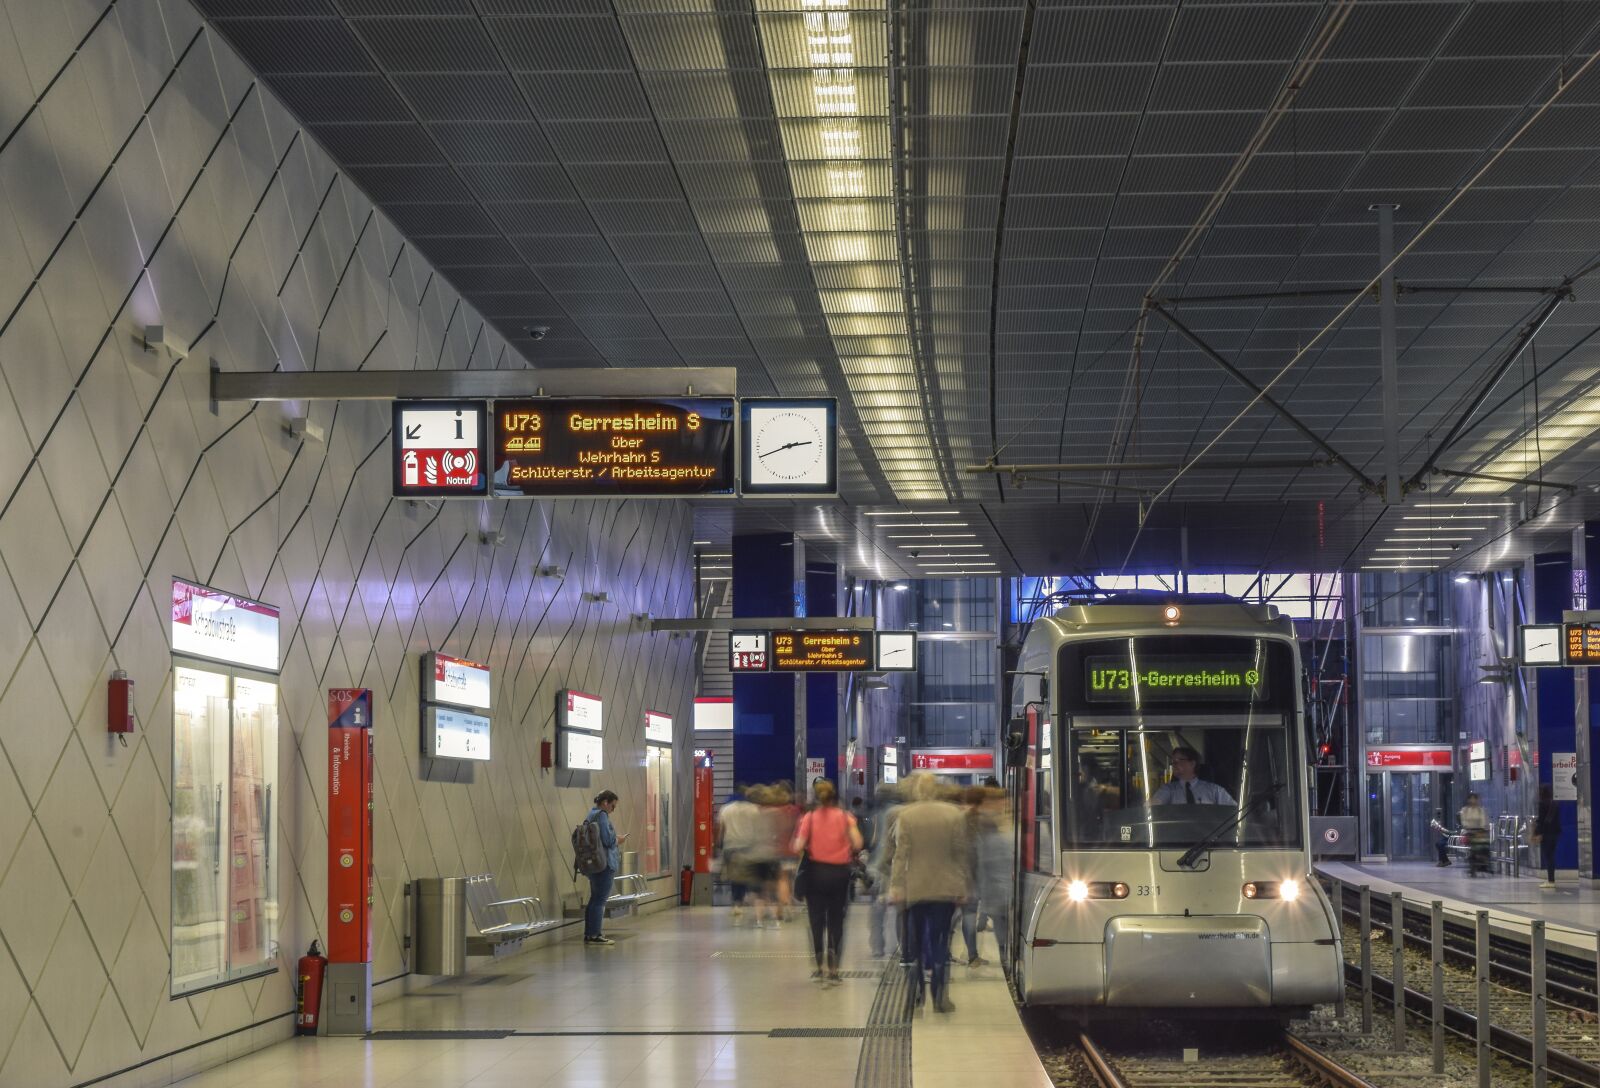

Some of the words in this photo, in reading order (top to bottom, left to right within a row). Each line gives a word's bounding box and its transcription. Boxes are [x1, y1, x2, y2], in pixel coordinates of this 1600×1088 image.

[505, 414, 541, 431] U73
[570, 413, 677, 431] Gerresheim
[687, 413, 700, 430] S
[612, 436, 644, 448] über
[580, 451, 646, 463] Wehrhahn
[651, 451, 660, 463] S
[512, 466, 594, 478] Schlüterstr.
[612, 466, 715, 480] Arbeitsagentur
[446, 476, 473, 485] Notruf
[776, 637, 793, 645] U73
[803, 636, 850, 645] Gerresheim
[853, 637, 860, 645] S
[1092, 670, 1129, 690] U73
[330, 690, 353, 702] SOS
[694, 749, 706, 757] SOS
[333, 754, 341, 795] Information
[1137, 885, 1161, 896] 331
